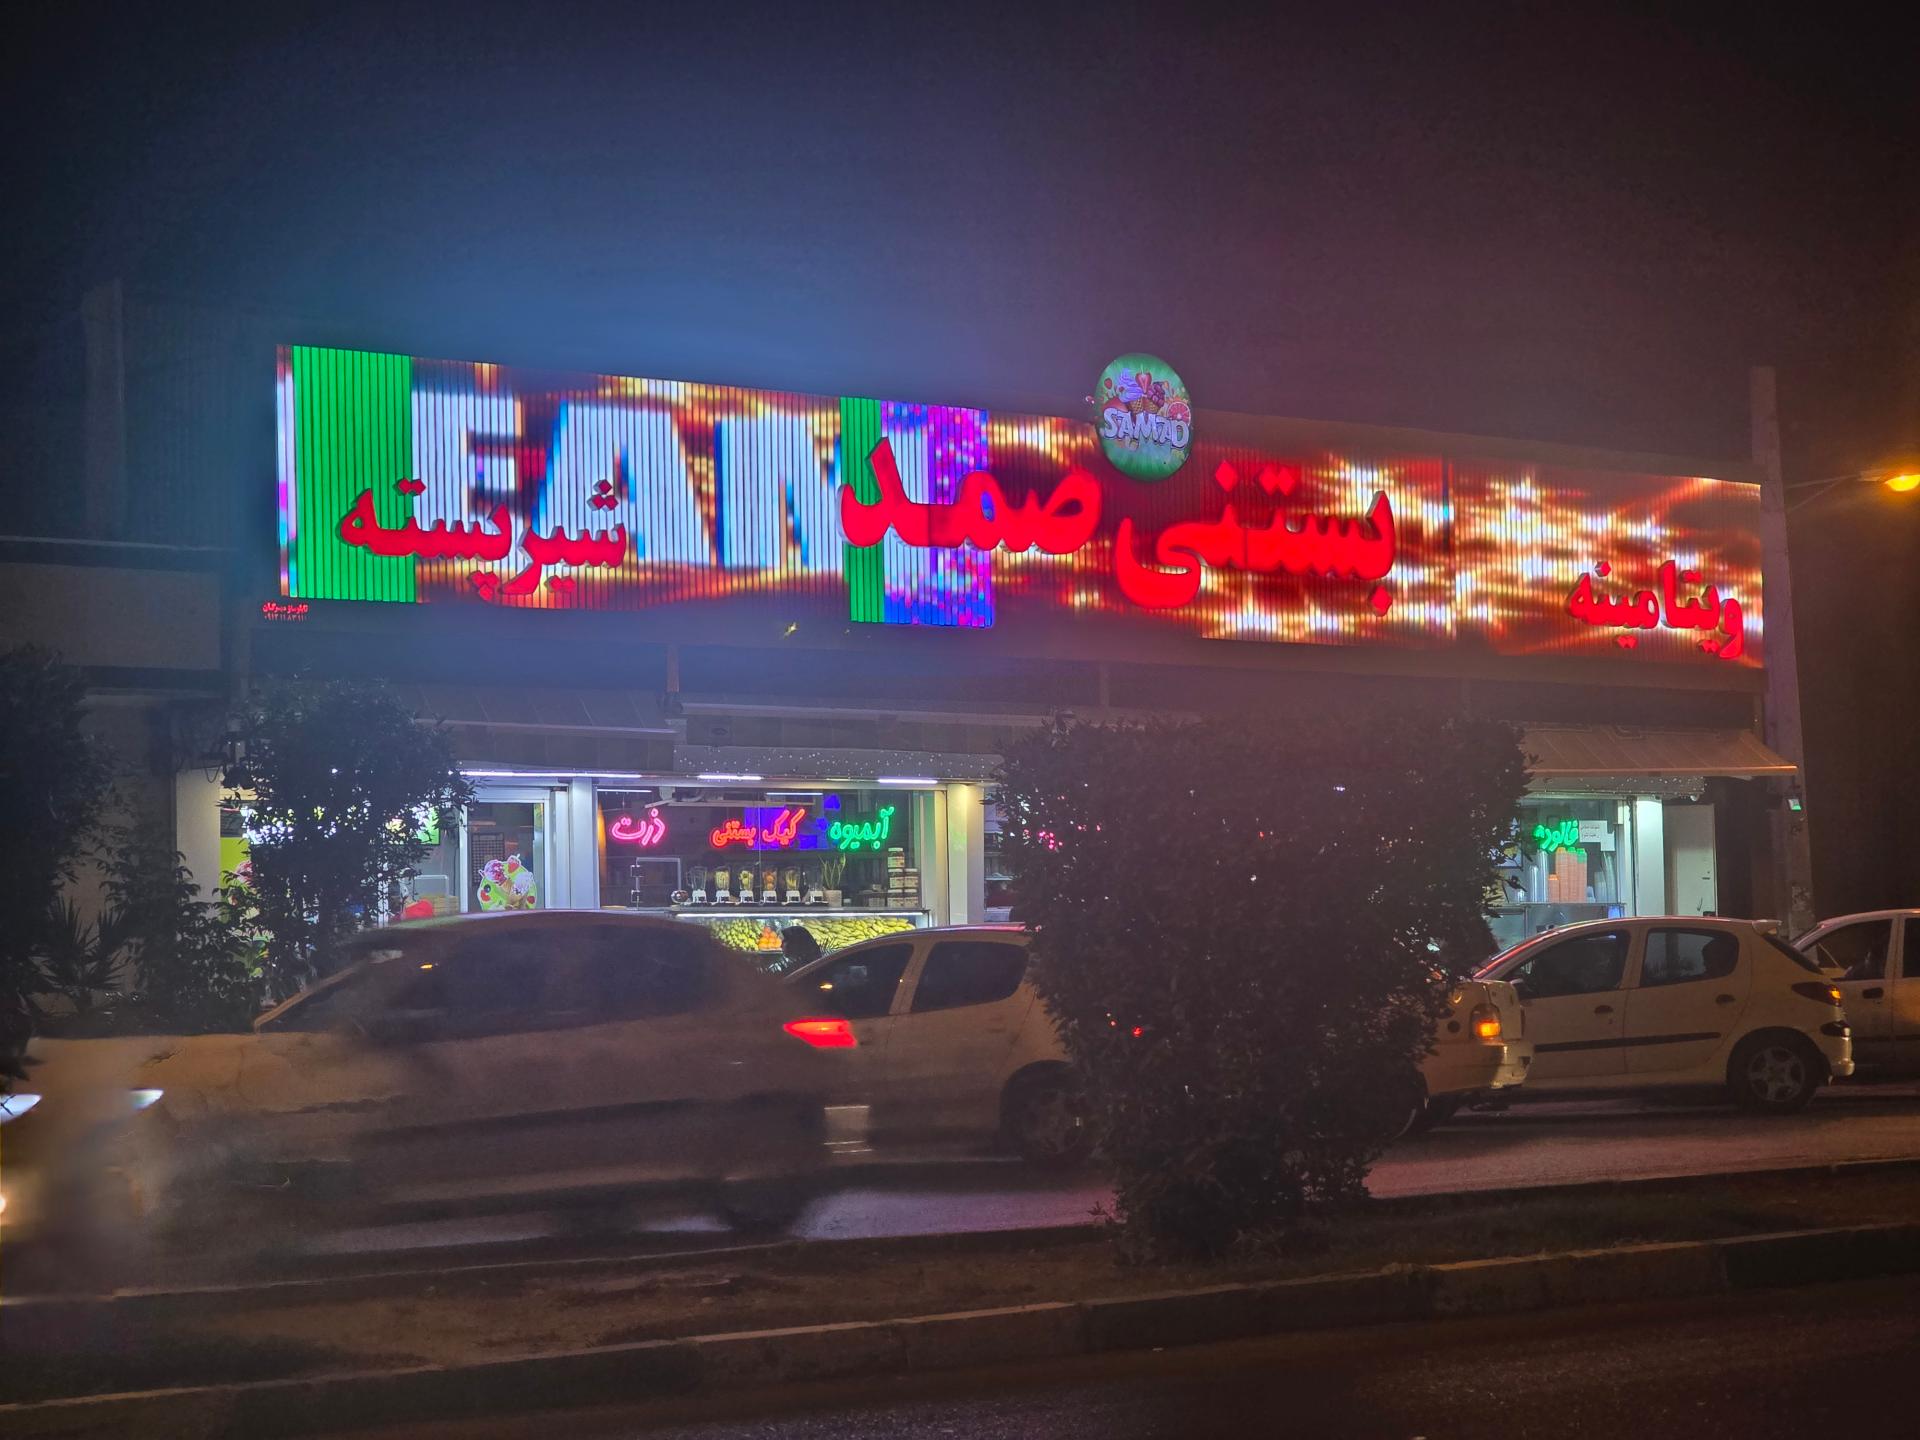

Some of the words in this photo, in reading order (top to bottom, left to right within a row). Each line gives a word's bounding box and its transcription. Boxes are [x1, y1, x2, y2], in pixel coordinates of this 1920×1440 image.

[1103, 407, 1189, 448] SAMAD
[838, 436, 1099, 555] صمد
[1116, 460, 1394, 617] بستنی
[1567, 559, 1744, 659] ویتامینه
[611, 808, 666, 846] ذرت
[712, 820, 757, 847] بستنی
[763, 808, 805, 846] کیک
[829, 806, 896, 850] آبمیوه
